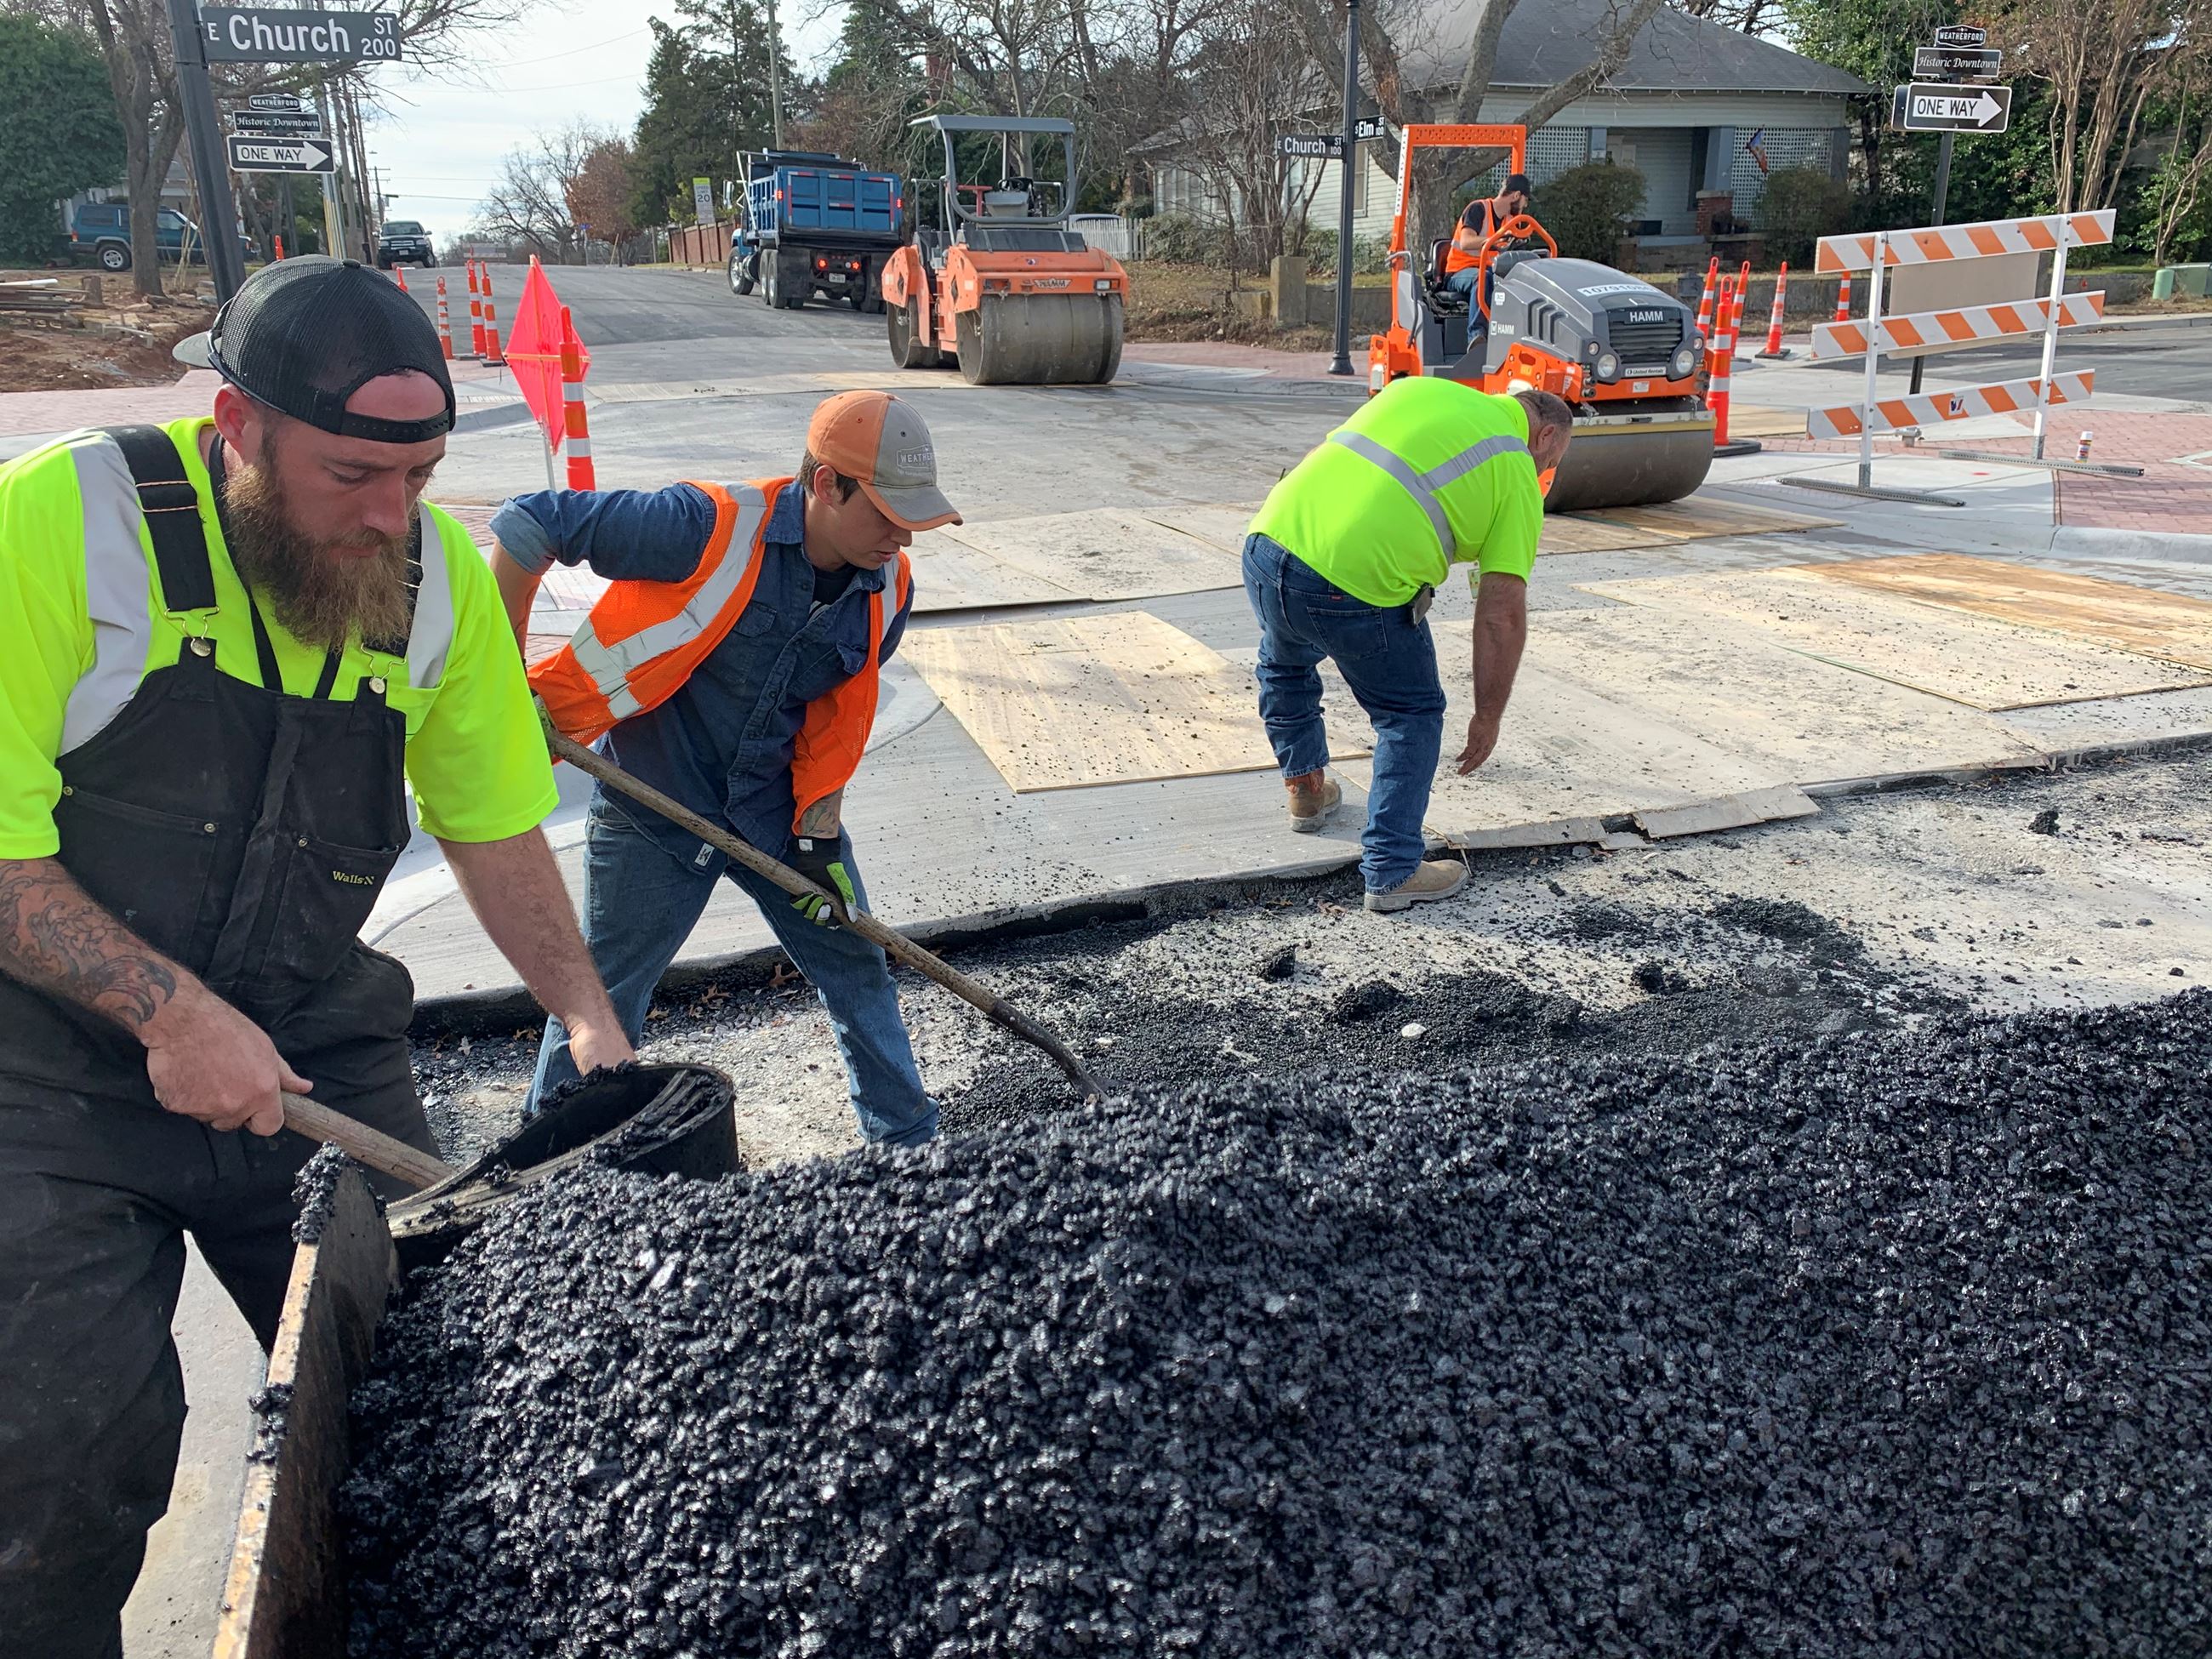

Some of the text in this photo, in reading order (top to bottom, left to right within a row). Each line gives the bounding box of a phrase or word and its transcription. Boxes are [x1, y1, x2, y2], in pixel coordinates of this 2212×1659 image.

[208, 14, 393, 53] E Church ST
[1940, 31, 1983, 41] WEATHERFORD
[361, 37, 396, 56] 200
[1918, 54, 1997, 69] Historic Downtown
[252, 98, 299, 107] WEATHERFORD
[1918, 99, 1978, 117] ONE WAY
[237, 116, 319, 128] Historic Downtown
[1359, 121, 1374, 137] Elm
[1378, 117, 1385, 126] ST
[1277, 137, 1343, 153] E Church ST
[1330, 146, 1343, 155] 100
[241, 146, 302, 162] ONE WAY
[1629, 311, 1663, 322] HAMM
[1497, 323, 1514, 334] HAMM
[333, 870, 365, 884] Walls
